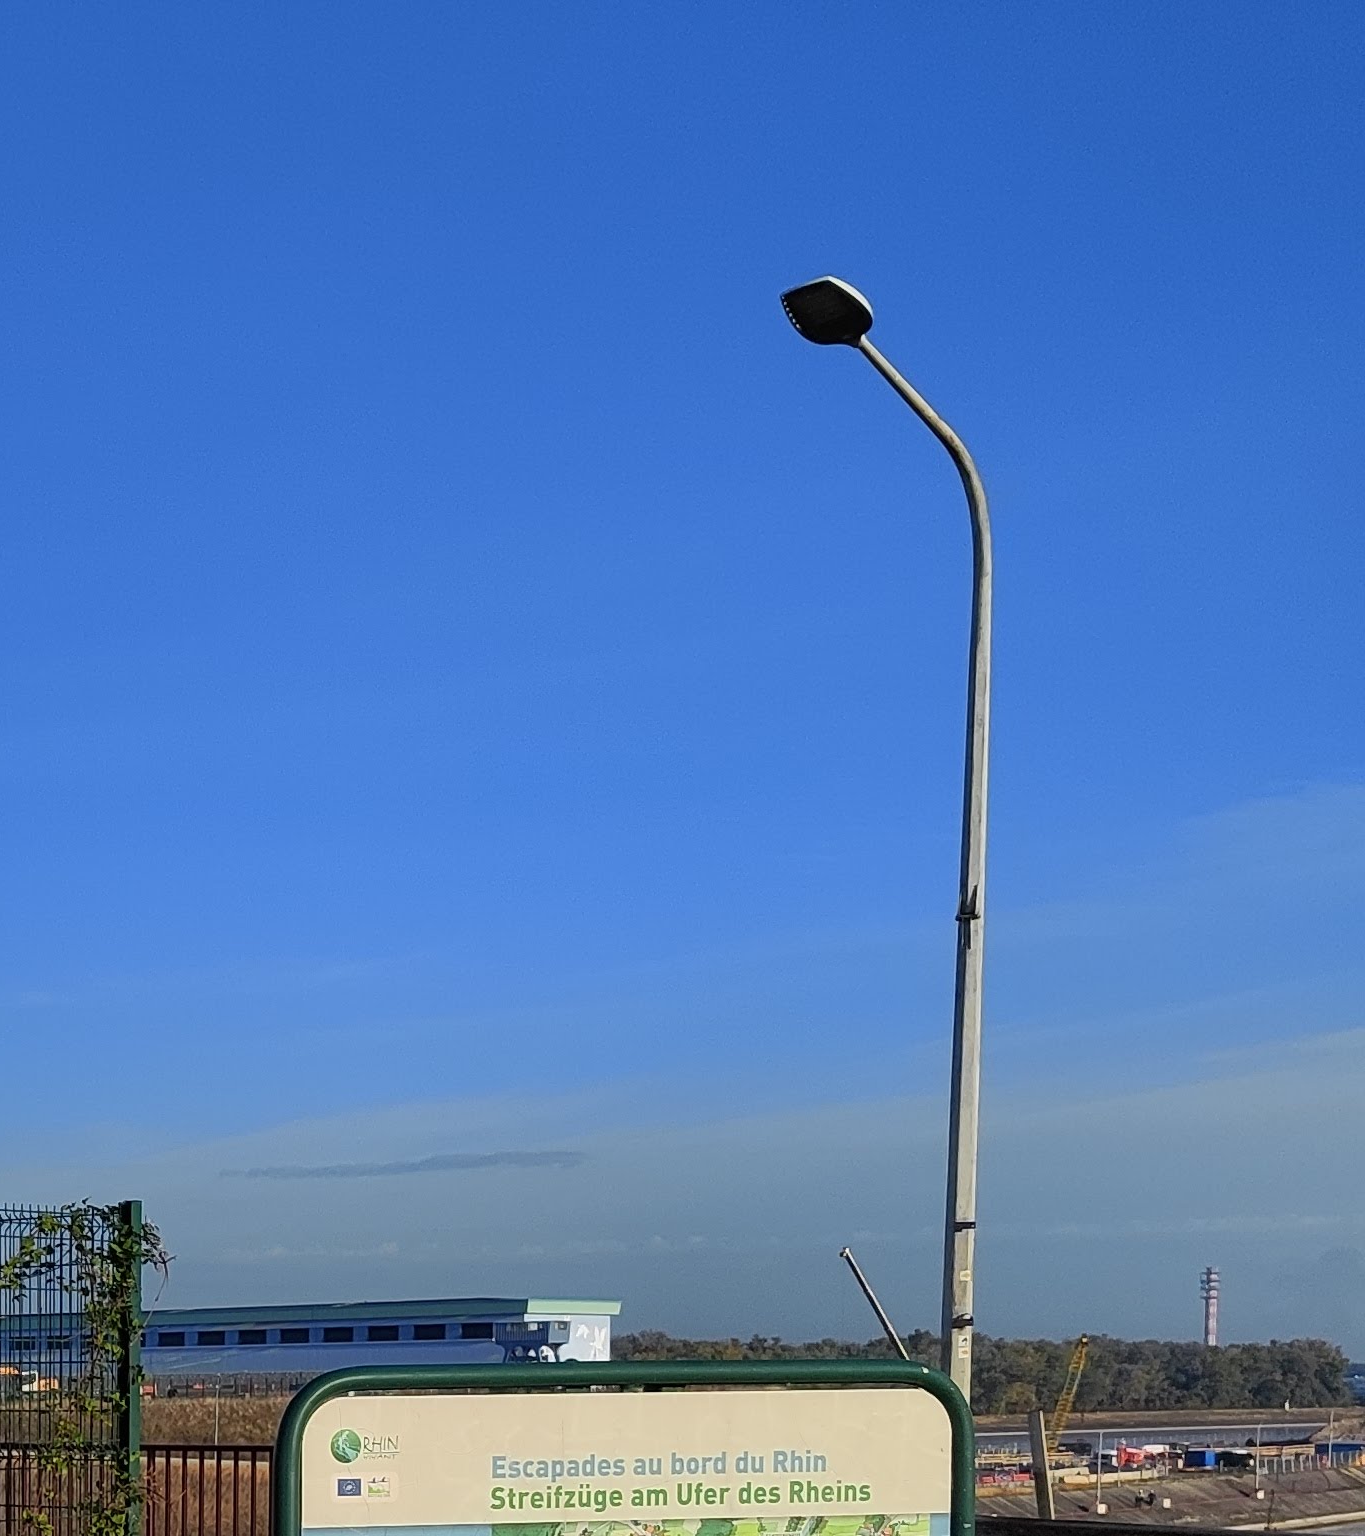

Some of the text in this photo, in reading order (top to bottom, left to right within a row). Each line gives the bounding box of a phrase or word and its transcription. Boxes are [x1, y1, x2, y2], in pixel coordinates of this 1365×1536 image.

[363, 1435, 399, 1452] RHIN
[490, 1450, 827, 1482] Escapades au bord du Rhin
[490, 1480, 871, 1513] Streifzüge am Ufer des Rheins
